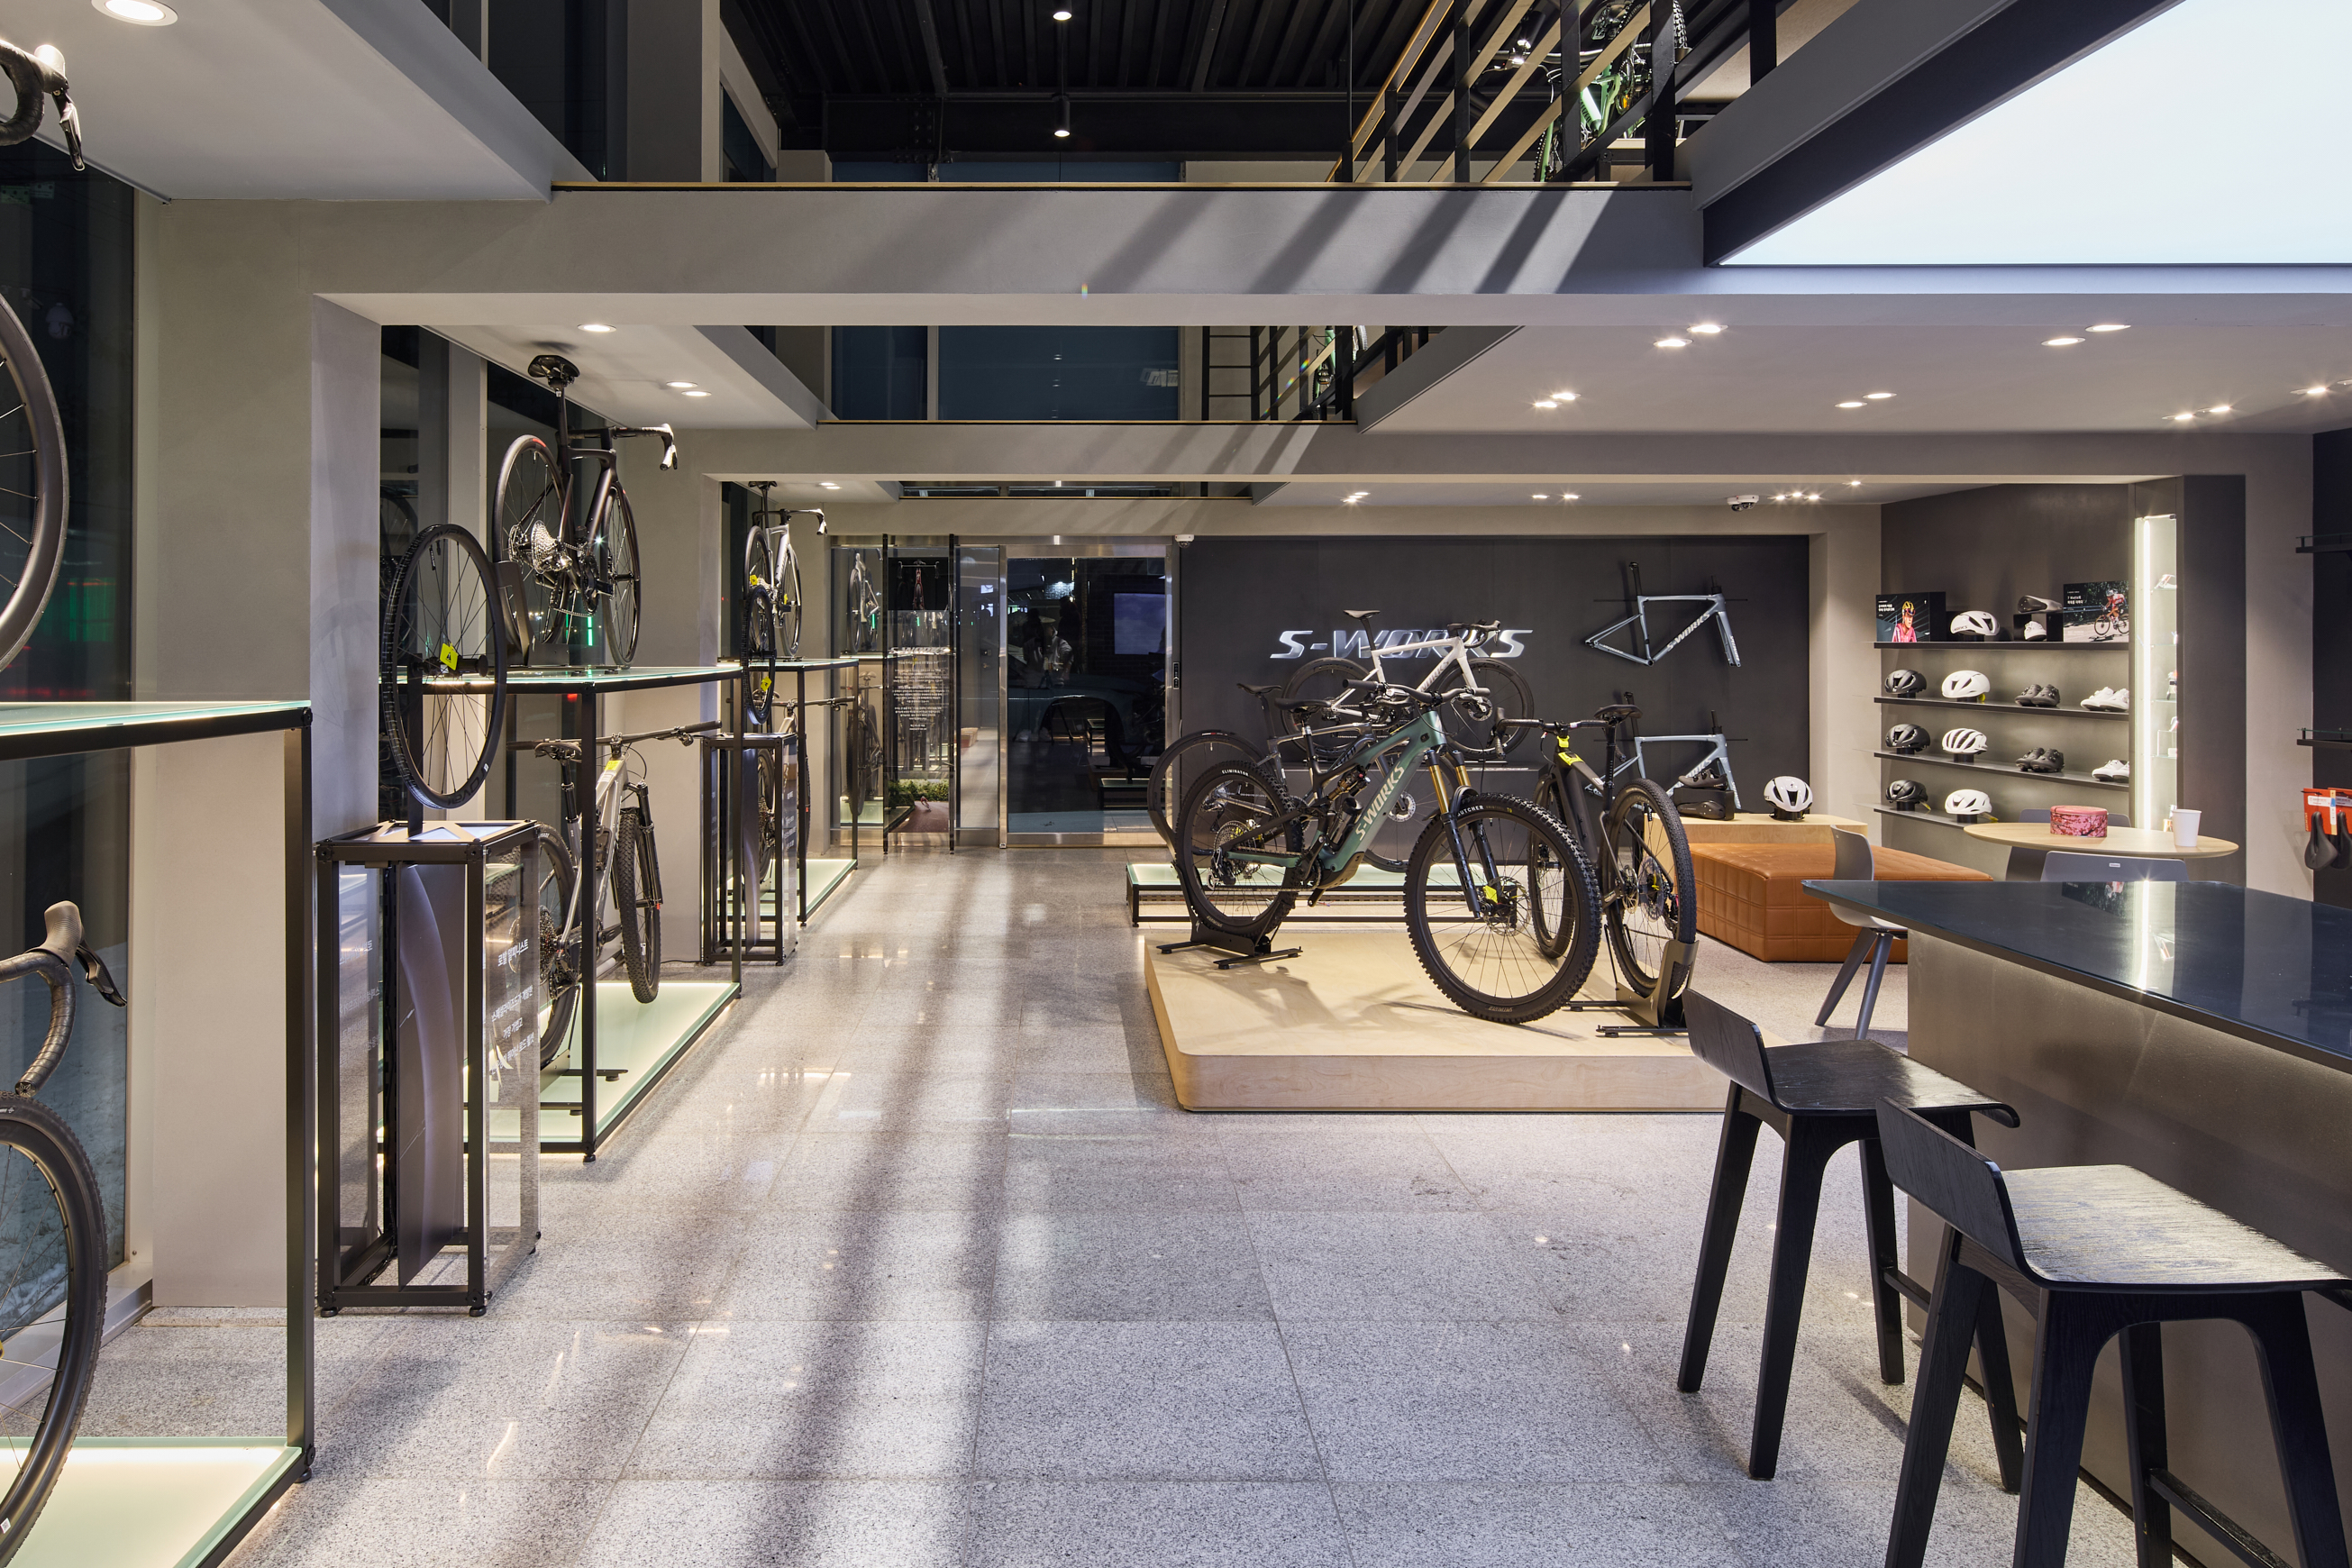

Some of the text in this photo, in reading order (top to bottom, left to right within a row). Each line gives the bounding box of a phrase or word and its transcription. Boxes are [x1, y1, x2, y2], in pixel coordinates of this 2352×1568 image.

[1270, 629, 1533, 659] S-WORKS
[1666, 610, 1710, 652] S-WORKS
[1221, 769, 1249, 777] ELIMINATOR
[1355, 761, 1405, 842] S-WORKS
